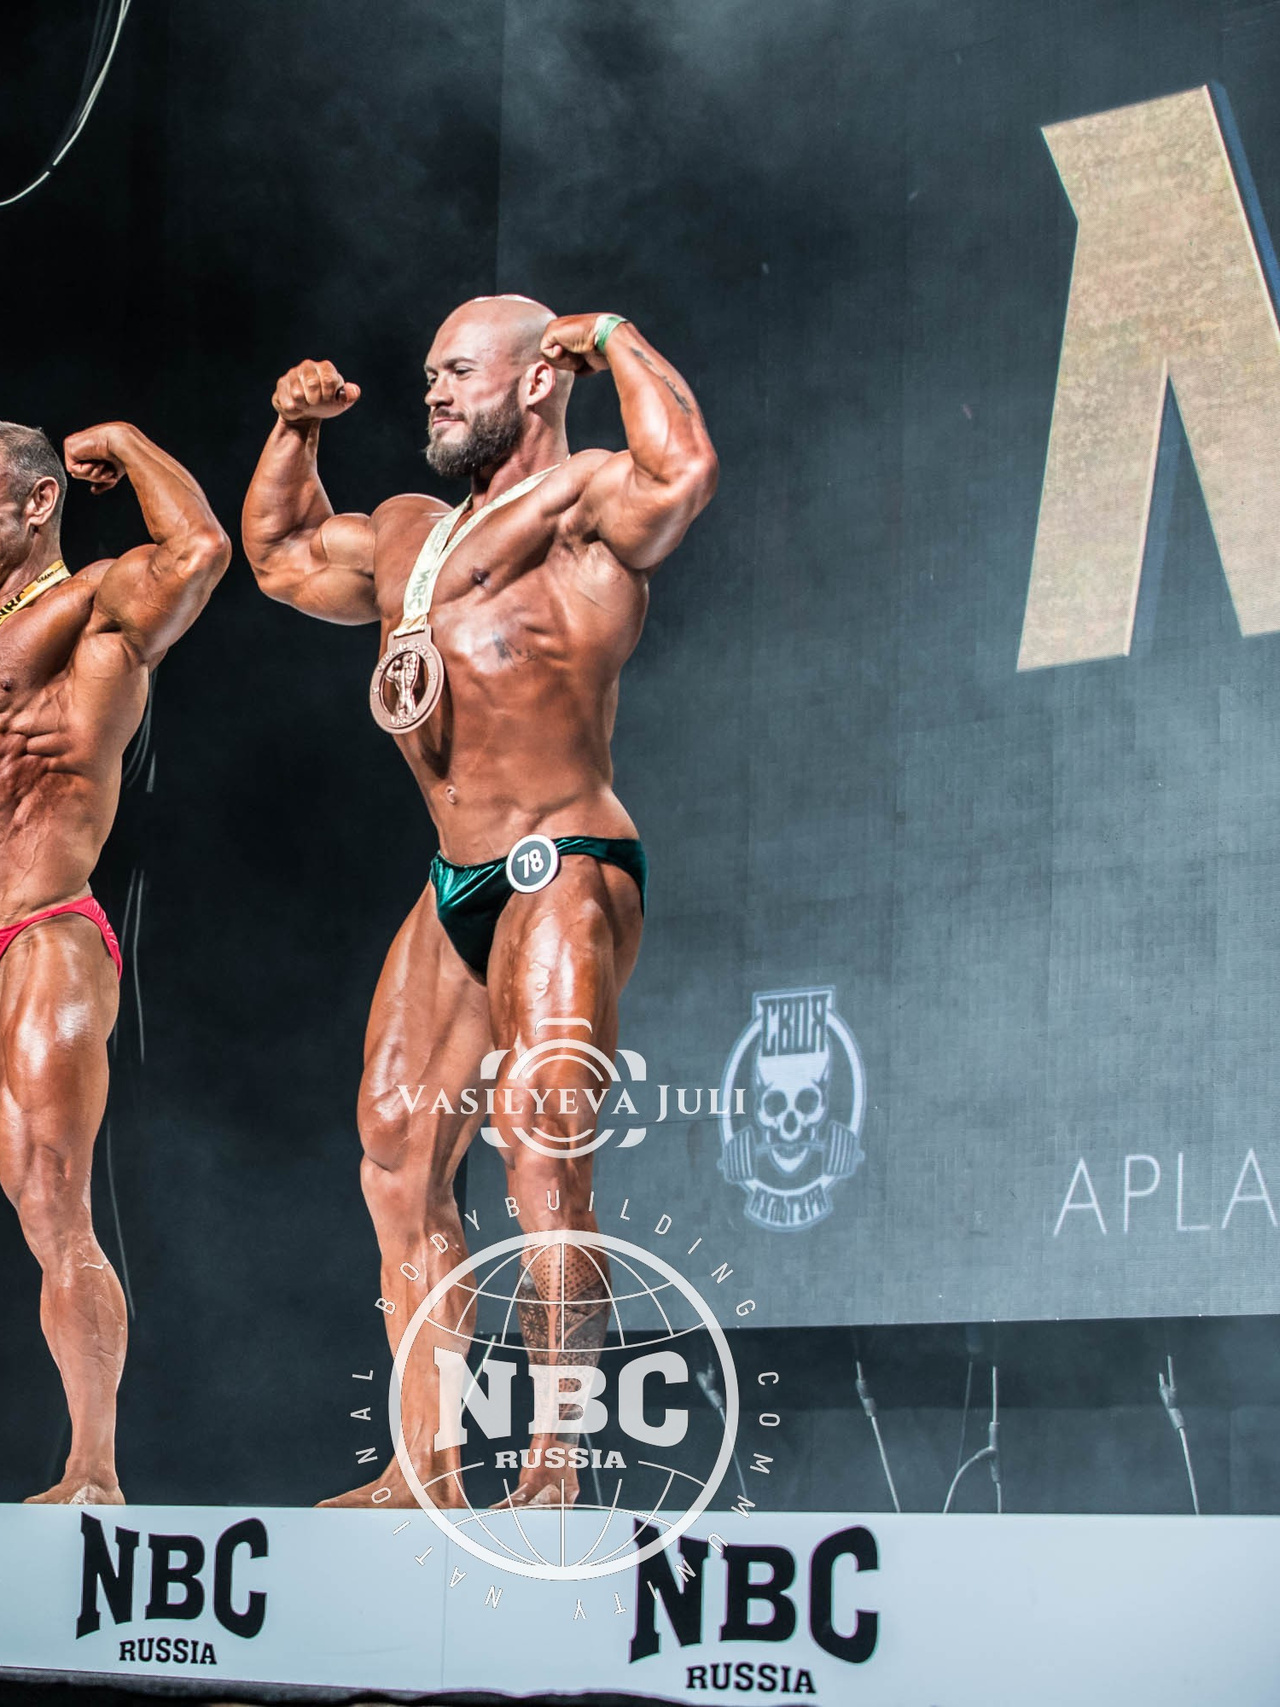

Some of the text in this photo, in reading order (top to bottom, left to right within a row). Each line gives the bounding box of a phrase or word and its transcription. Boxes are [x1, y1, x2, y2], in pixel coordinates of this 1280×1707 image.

[517, 848, 545, 879] 78
[1053, 1148, 1279, 1237] APLA
[76, 1511, 270, 1640] NBC
[630, 1518, 880, 1664] NBC
[119, 1637, 218, 1665] RUSSIA
[686, 1662, 817, 1694] RUSSIA
